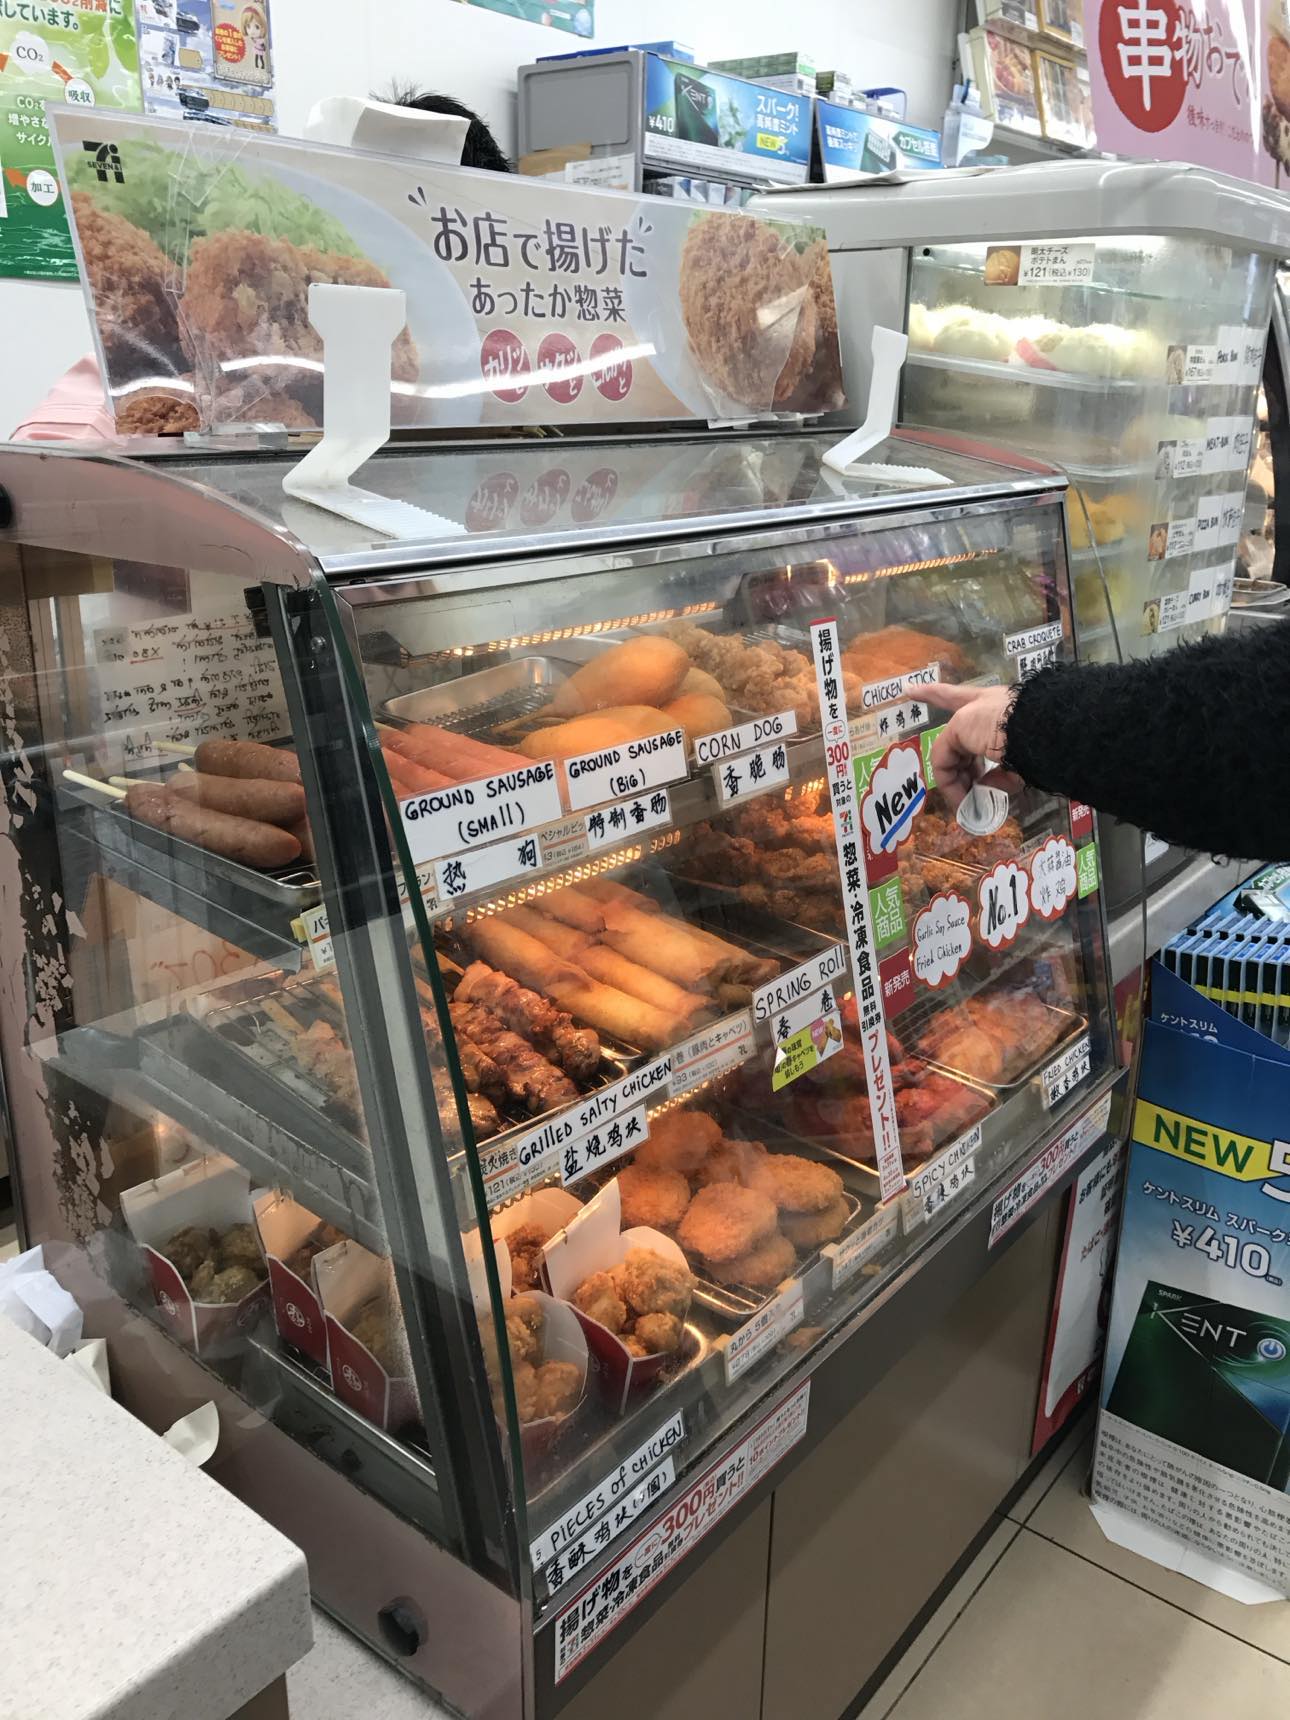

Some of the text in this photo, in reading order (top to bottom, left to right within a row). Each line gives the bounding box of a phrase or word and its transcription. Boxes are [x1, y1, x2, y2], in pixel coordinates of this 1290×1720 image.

[68, 90, 92, 103] 吸収
[757, 95, 799, 122] スパーク!
[31, 180, 54, 194] 加工
[431, 207, 647, 277] お店で揚げた
[470, 277, 626, 322] あったか惣菜
[569, 730, 683, 778] GROUND SAUSAGE
[698, 717, 782, 762] CORN DOG
[405, 763, 554, 821] GROUND SAUSAGE
[875, 771, 919, 836] New
[875, 885, 899, 919] 人気
[877, 909, 905, 942] 商品
[917, 943, 963, 972] Fried Chicken
[755, 973, 811, 1021] SPRING
[884, 968, 911, 997] 新発売
[1160, 1011, 1218, 1034] ケントスリム
[1153, 1113, 1255, 1174] NEW
[1143, 1180, 1221, 1222] ケントスリム
[1171, 1218, 1271, 1281] ¥410
[551, 1493, 605, 1551] PIECES
[559, 1562, 634, 1645] 揚げ物を
